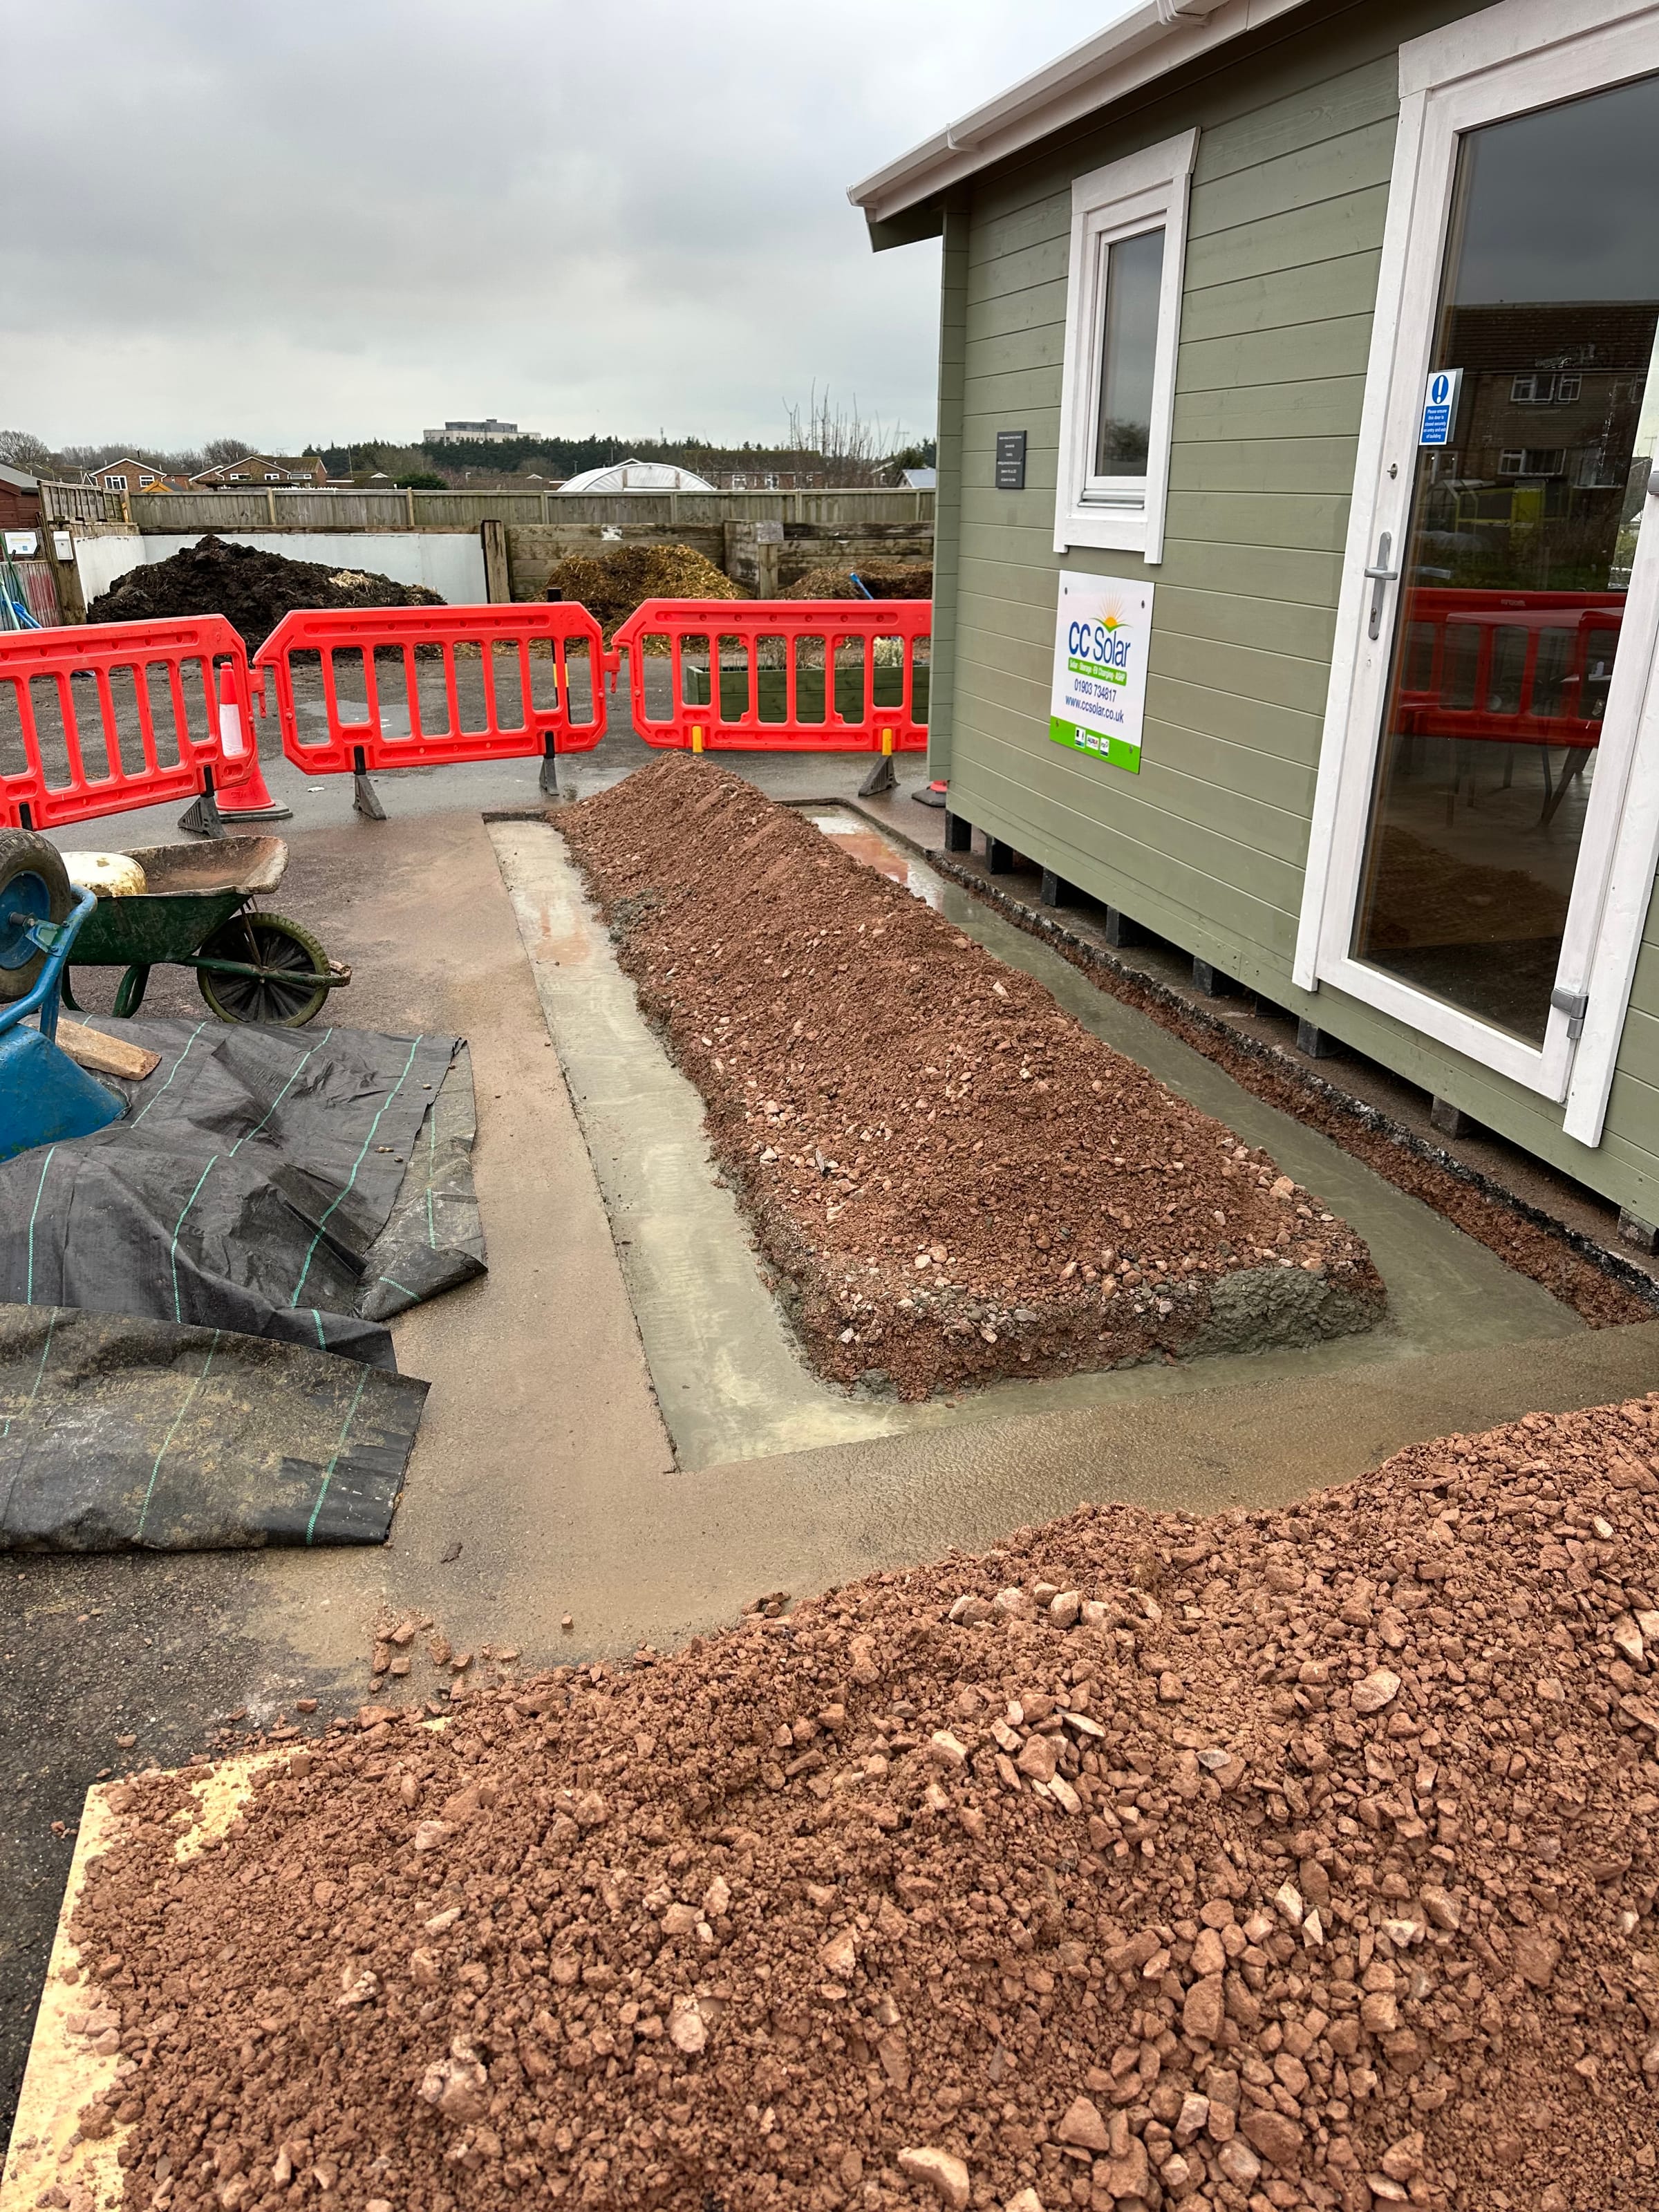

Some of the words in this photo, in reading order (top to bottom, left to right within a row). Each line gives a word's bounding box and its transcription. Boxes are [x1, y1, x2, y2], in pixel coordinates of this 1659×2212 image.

[1069, 621, 1091, 657] CC
[1093, 626, 1131, 667] Solar
[1069, 659, 1078, 668] Solar
[1074, 678, 1092, 695] 01903
[1094, 684, 1116, 702] 734817
[1065, 695, 1124, 724] www.ccsolar.co.uk
